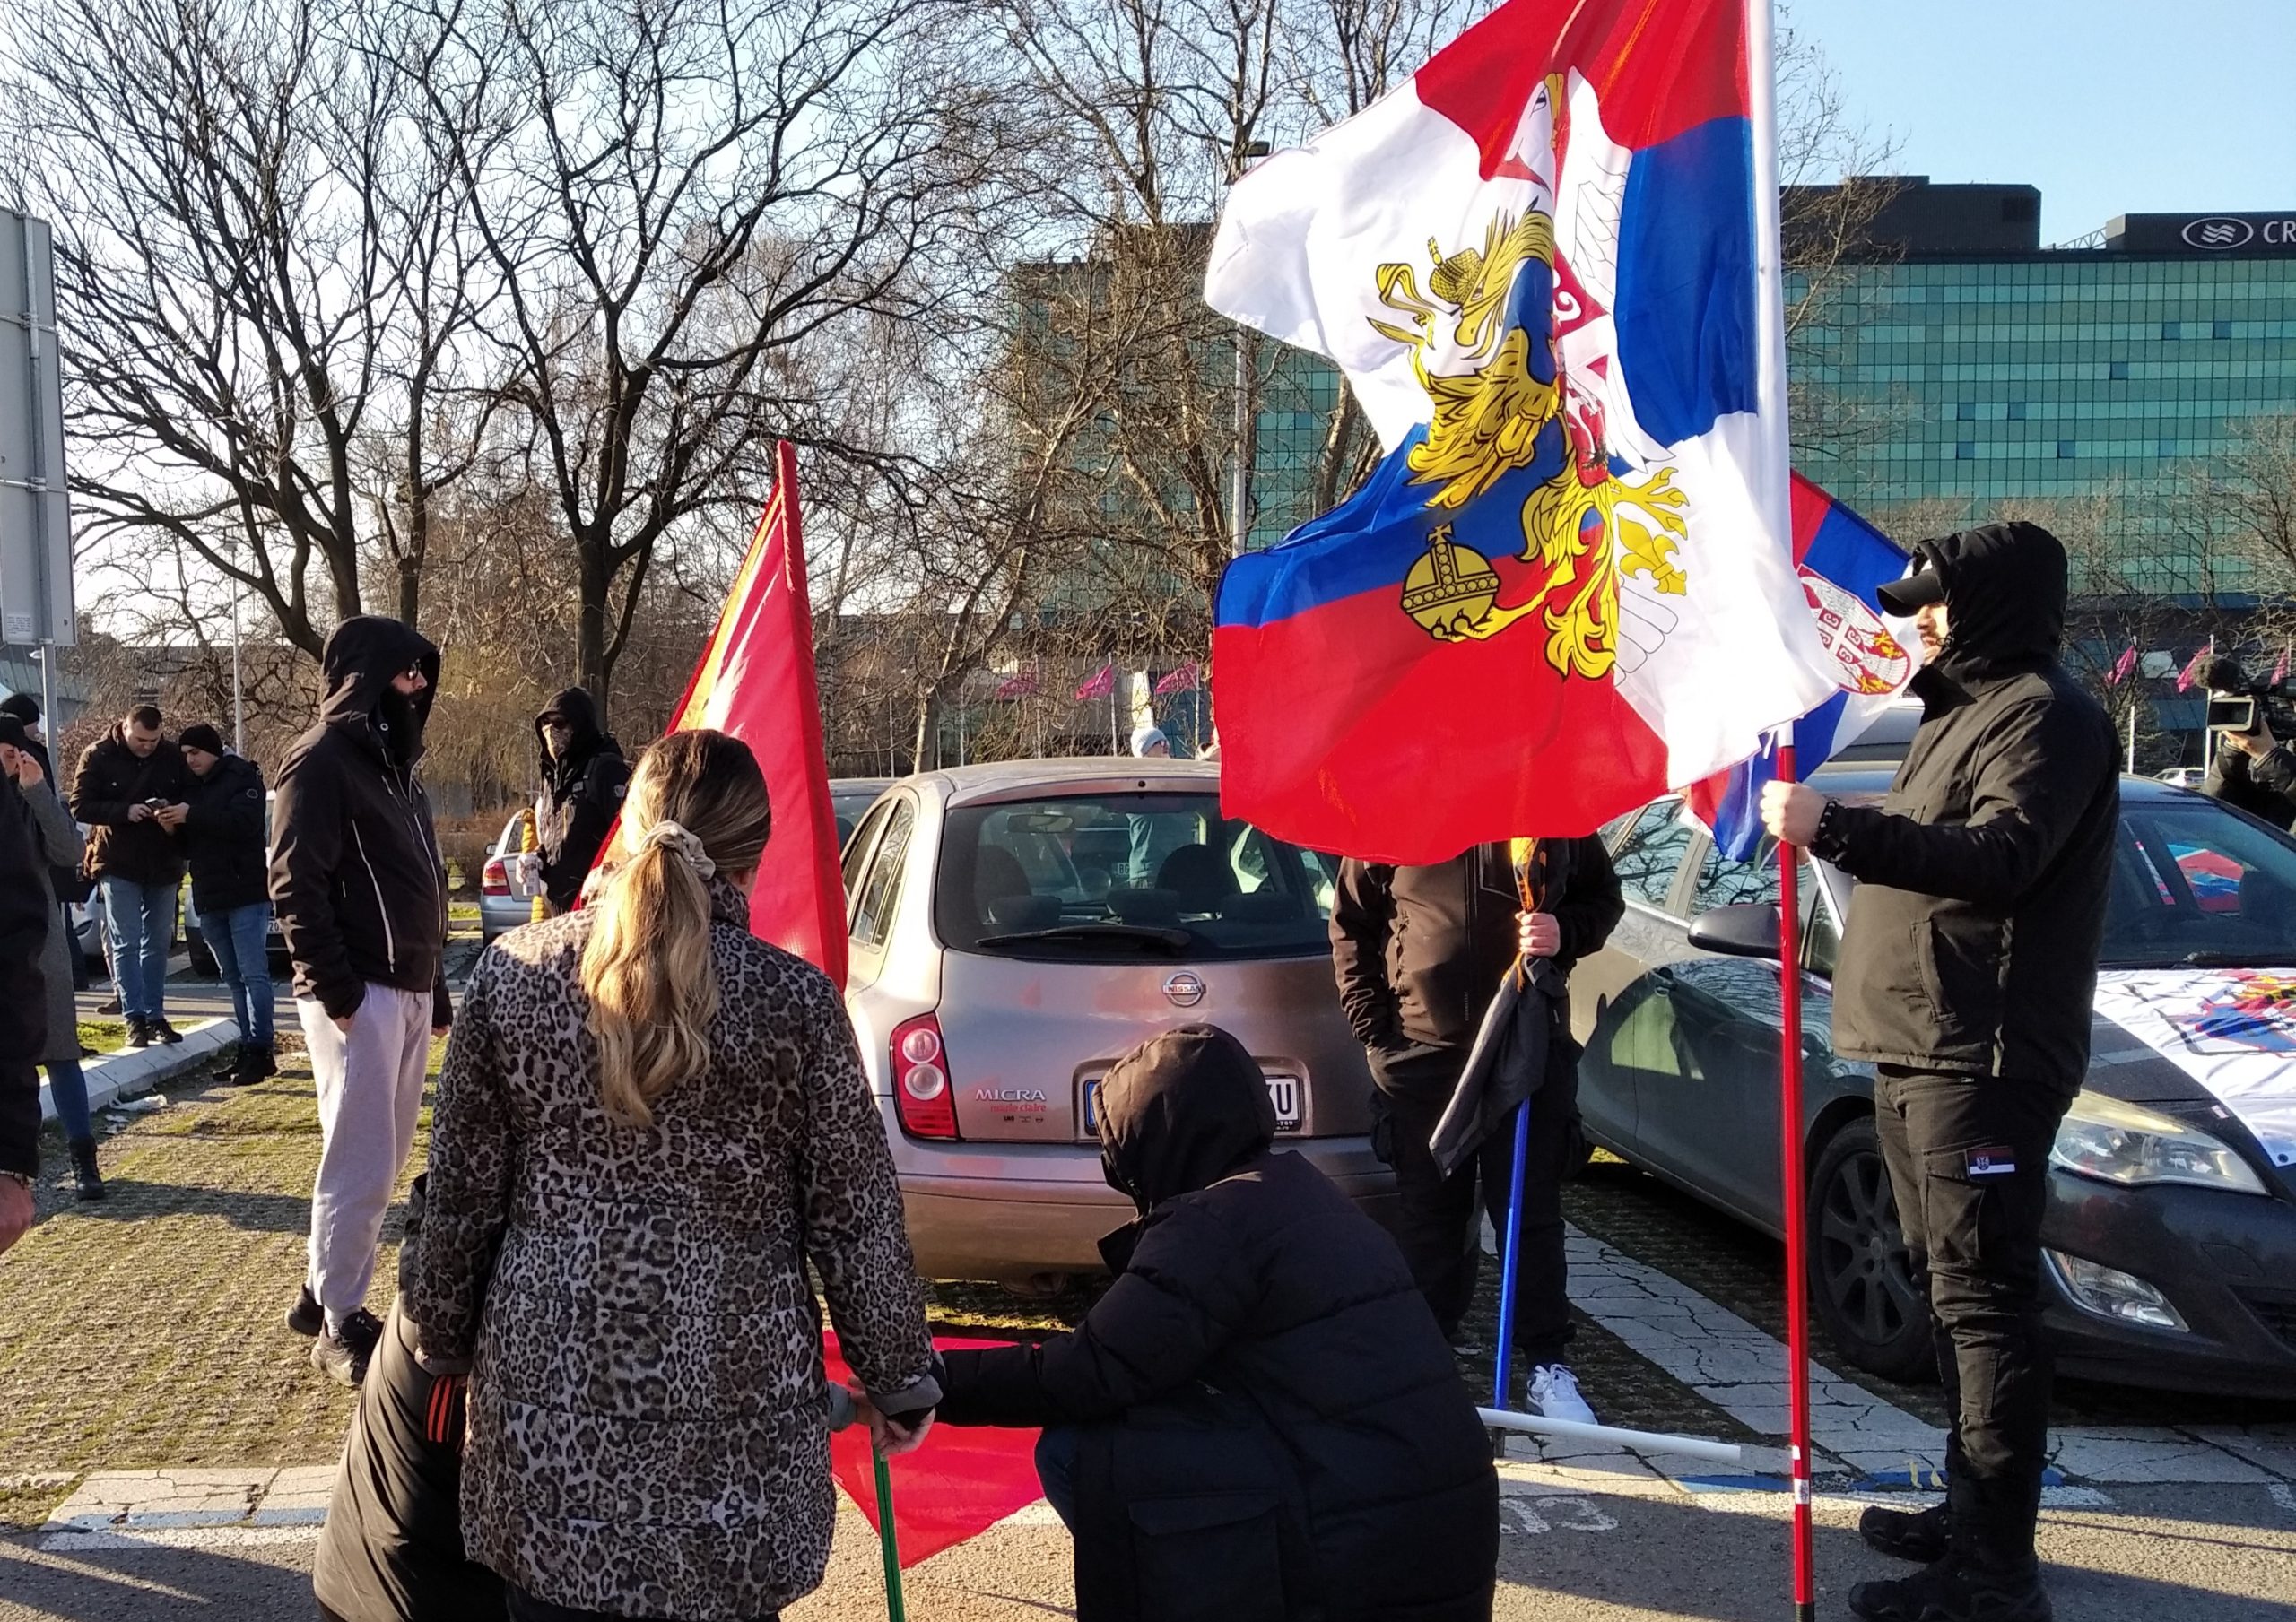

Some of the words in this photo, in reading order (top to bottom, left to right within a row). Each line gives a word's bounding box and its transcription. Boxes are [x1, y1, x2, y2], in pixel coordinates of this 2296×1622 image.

[2263, 221, 2296, 244] CR
[975, 1089, 1046, 1102] MICRA
[1019, 1103, 1047, 1112] claire
